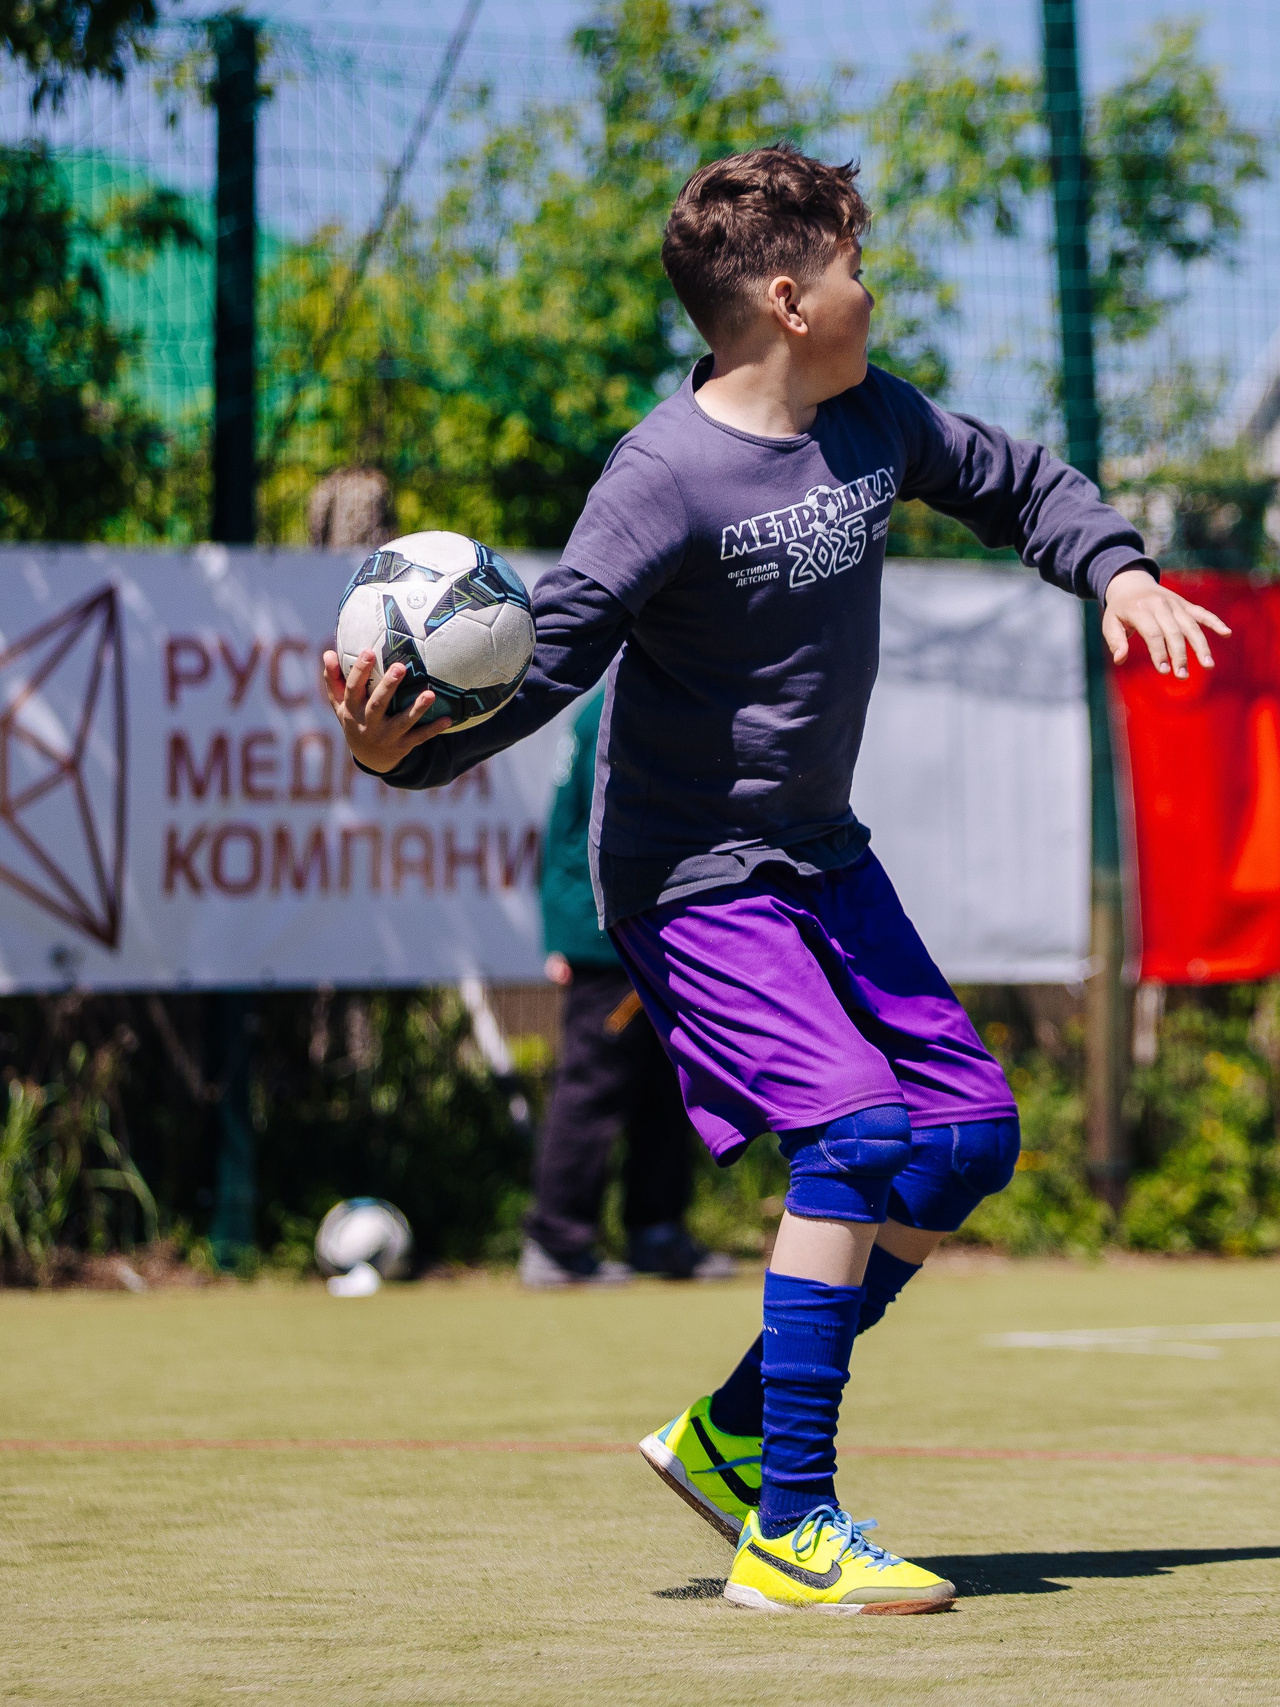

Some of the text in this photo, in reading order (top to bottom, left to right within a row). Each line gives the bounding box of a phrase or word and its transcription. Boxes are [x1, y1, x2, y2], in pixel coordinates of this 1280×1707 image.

[787, 516, 866, 588] 2025
[727, 561, 779, 579] ФЕСТИВАЛЬ
[735, 570, 780, 588] ДЕТСКОГО
